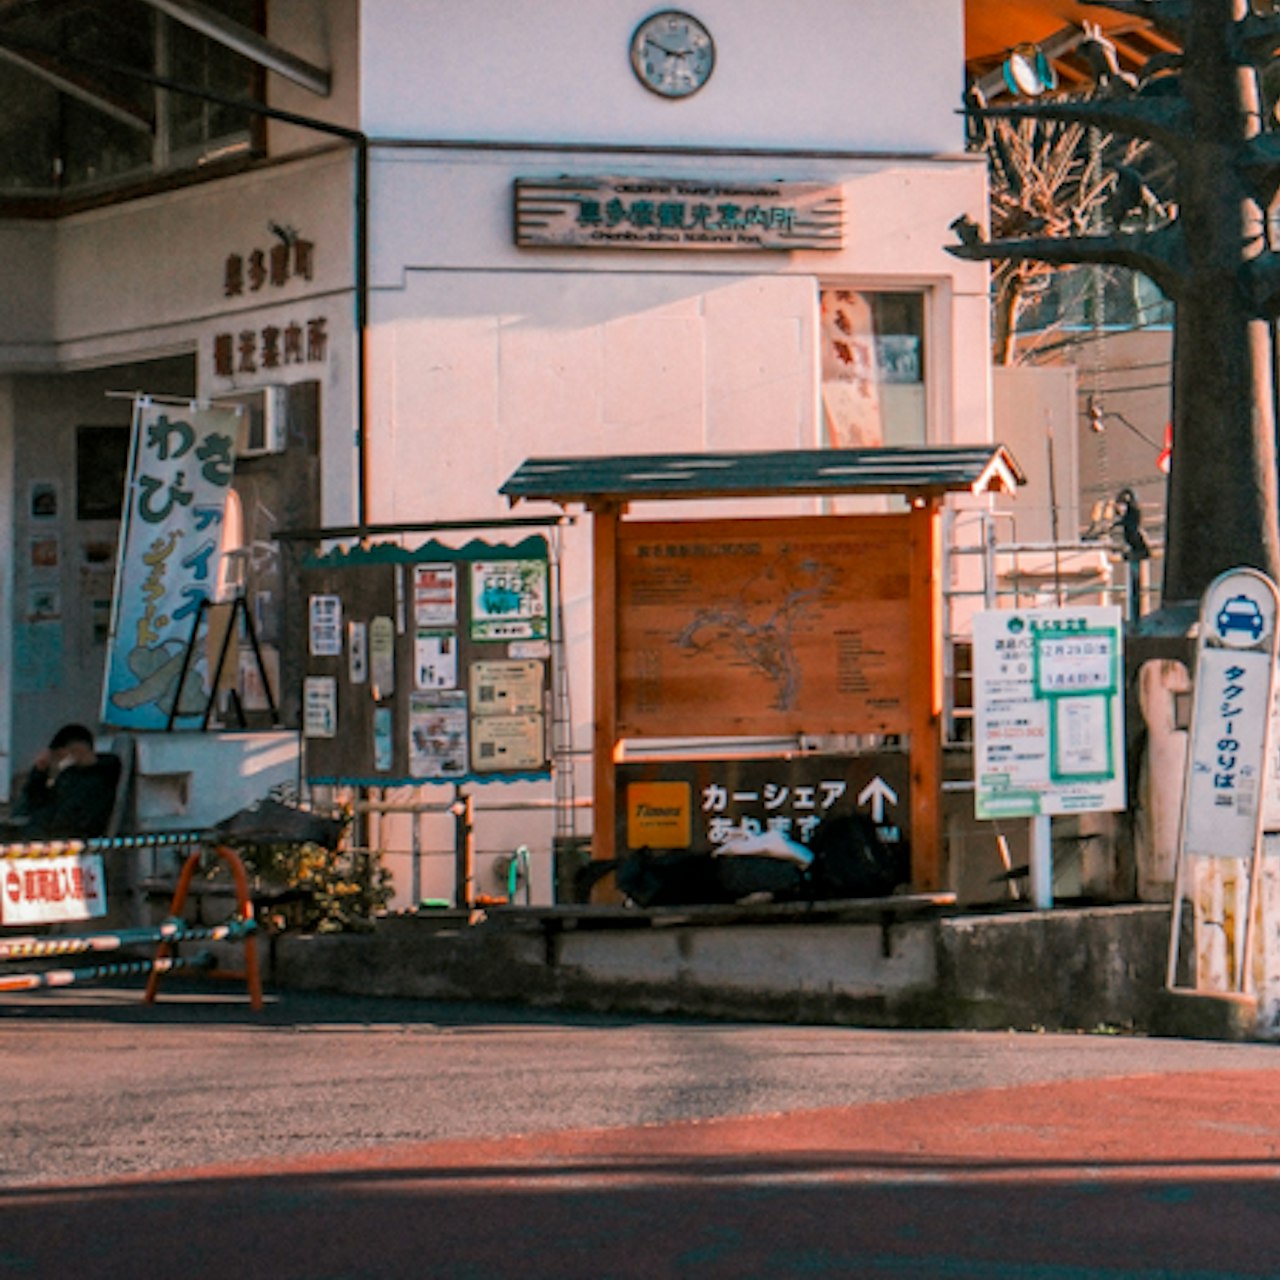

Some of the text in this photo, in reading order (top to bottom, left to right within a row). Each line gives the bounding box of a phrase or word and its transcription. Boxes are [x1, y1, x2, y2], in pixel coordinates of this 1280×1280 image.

[1214, 665, 1246, 790] タクシーのりば
[702, 781, 846, 811] カーシェア
